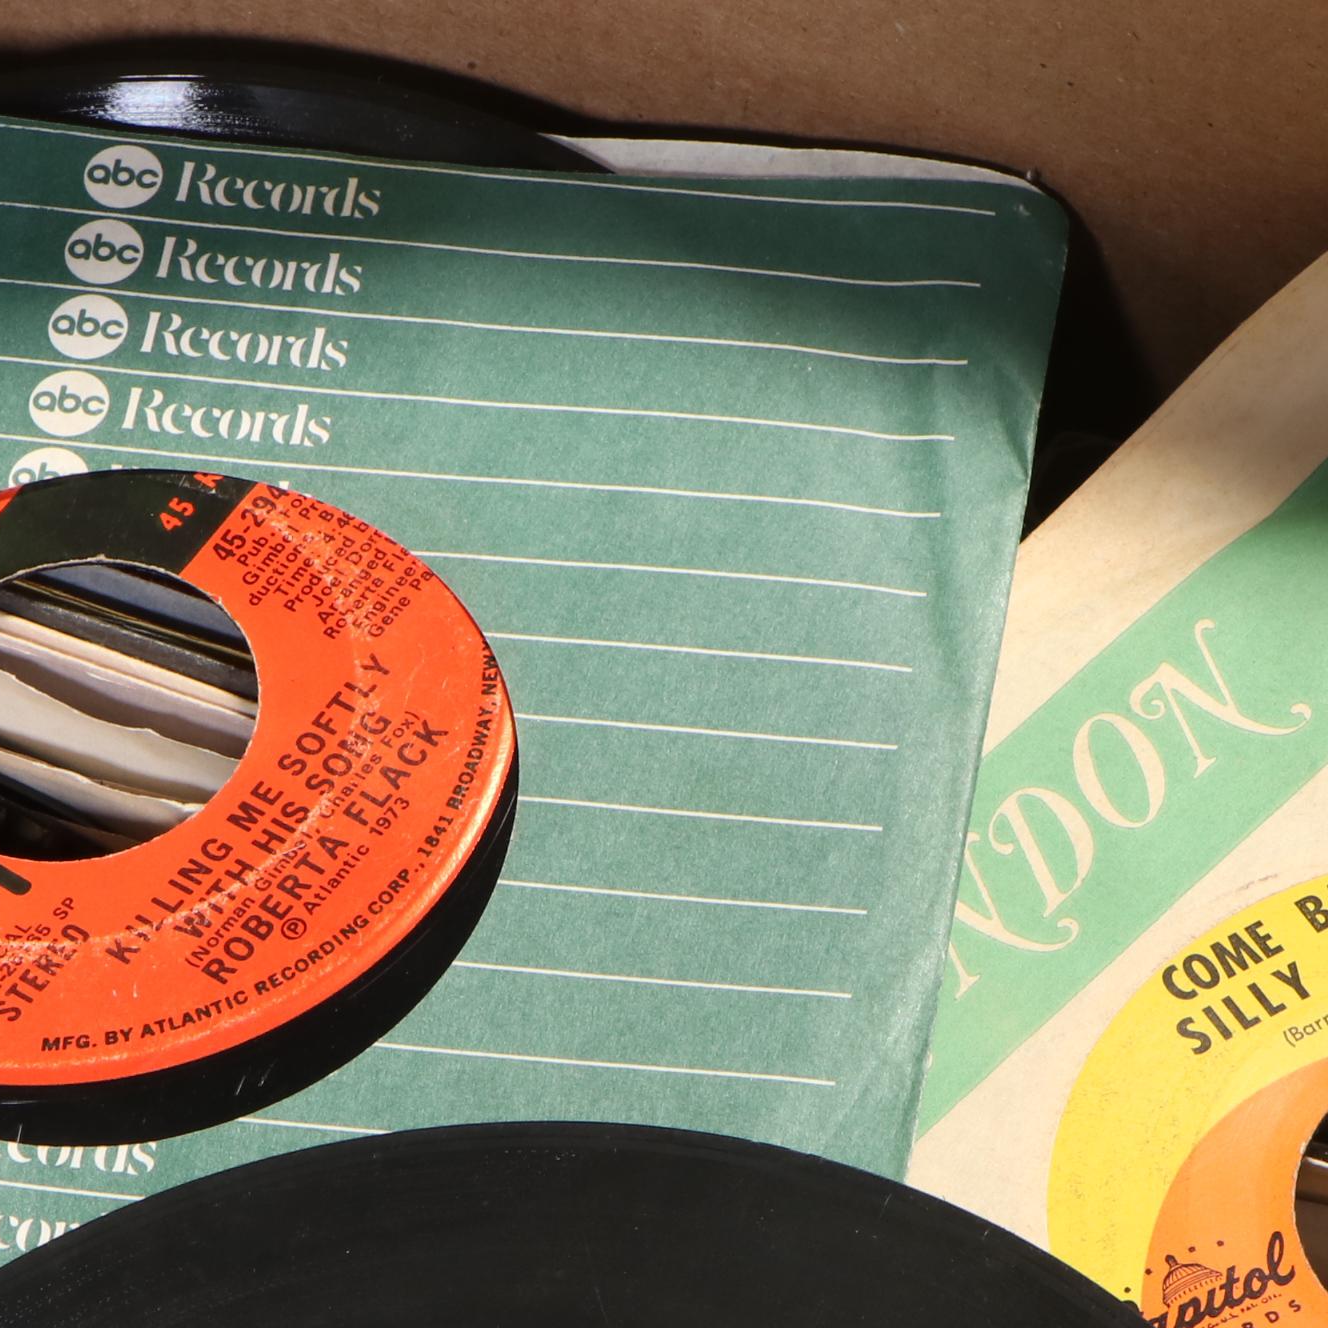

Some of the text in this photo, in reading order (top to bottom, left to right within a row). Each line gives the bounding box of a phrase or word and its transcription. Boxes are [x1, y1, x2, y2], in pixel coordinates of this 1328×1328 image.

[86, 159, 381, 218] abc Records
[67, 232, 363, 295] abc Records
[52, 308, 349, 371] abc Records
[33, 383, 332, 447] abc Records
[283, 538, 356, 613] Produced
[368, 597, 411, 638] Gene
[105, 652, 391, 966] KILLING ME SOFTLY
[173, 710, 393, 941] WITH HIS SONG
[185, 896, 255, 969] (Norman
[381, 709, 421, 749] Fox)
[201, 719, 449, 985] ROBERTA FLACK
[949, 619, 1312, 1001] NDON
[302, 842, 370, 916] Atlantic
[368, 796, 411, 837] 1973
[41, 1035, 97, 1052] MFG.
[104, 1027, 134, 1046] BY
[140, 989, 249, 1040] ATLANTIC
[255, 914, 370, 997] RECORDING
[416, 815, 454, 858] 1841
[53, 896, 76, 921] SP
[1161, 919, 1285, 1001] COME
[1175, 960, 1312, 1055] SILLY
